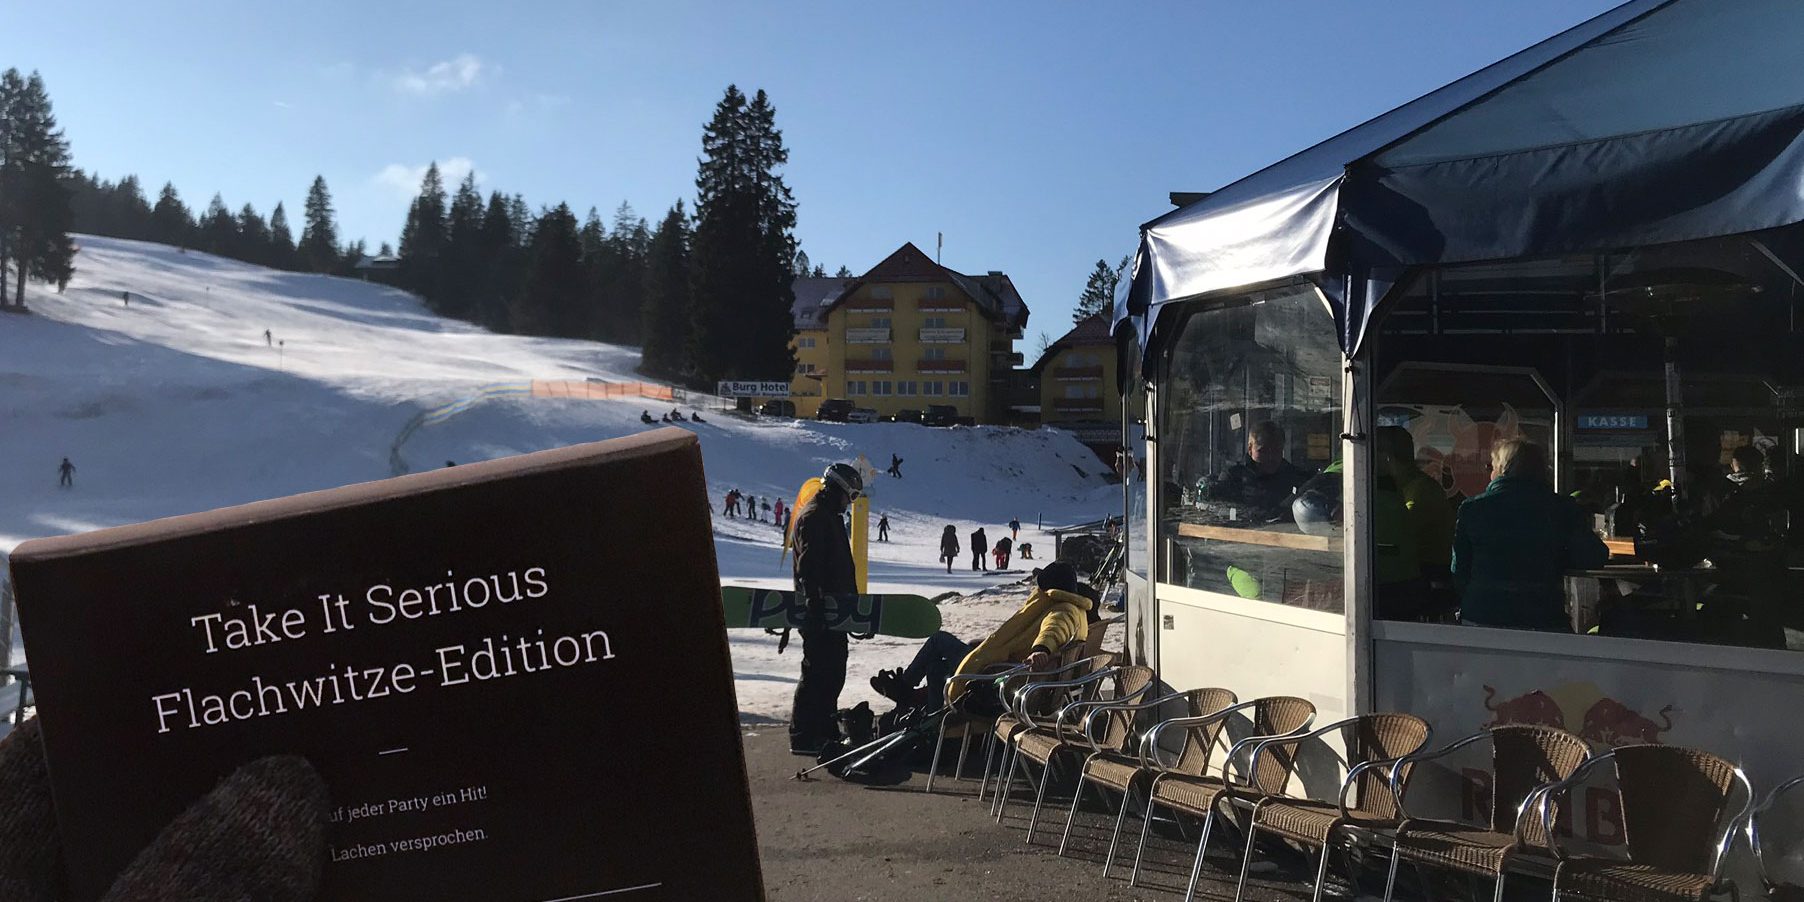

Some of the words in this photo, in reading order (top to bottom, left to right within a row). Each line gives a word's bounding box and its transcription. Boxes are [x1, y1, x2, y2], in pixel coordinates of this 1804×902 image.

[732, 383, 757, 393] Burg
[760, 383, 789, 392] Hotel
[1588, 416, 1637, 427] KASSE
[190, 604, 306, 654] Take
[318, 593, 355, 633] It
[366, 567, 548, 624] Serious
[151, 628, 616, 734] Flachwitze-Edition
[331, 807, 344, 822] uf
[347, 802, 385, 823] jeder
[387, 796, 429, 813] Party
[432, 791, 457, 807] ein
[459, 785, 488, 803] Hit!
[331, 843, 387, 862] Lachen
[389, 828, 489, 852] versprochen.
